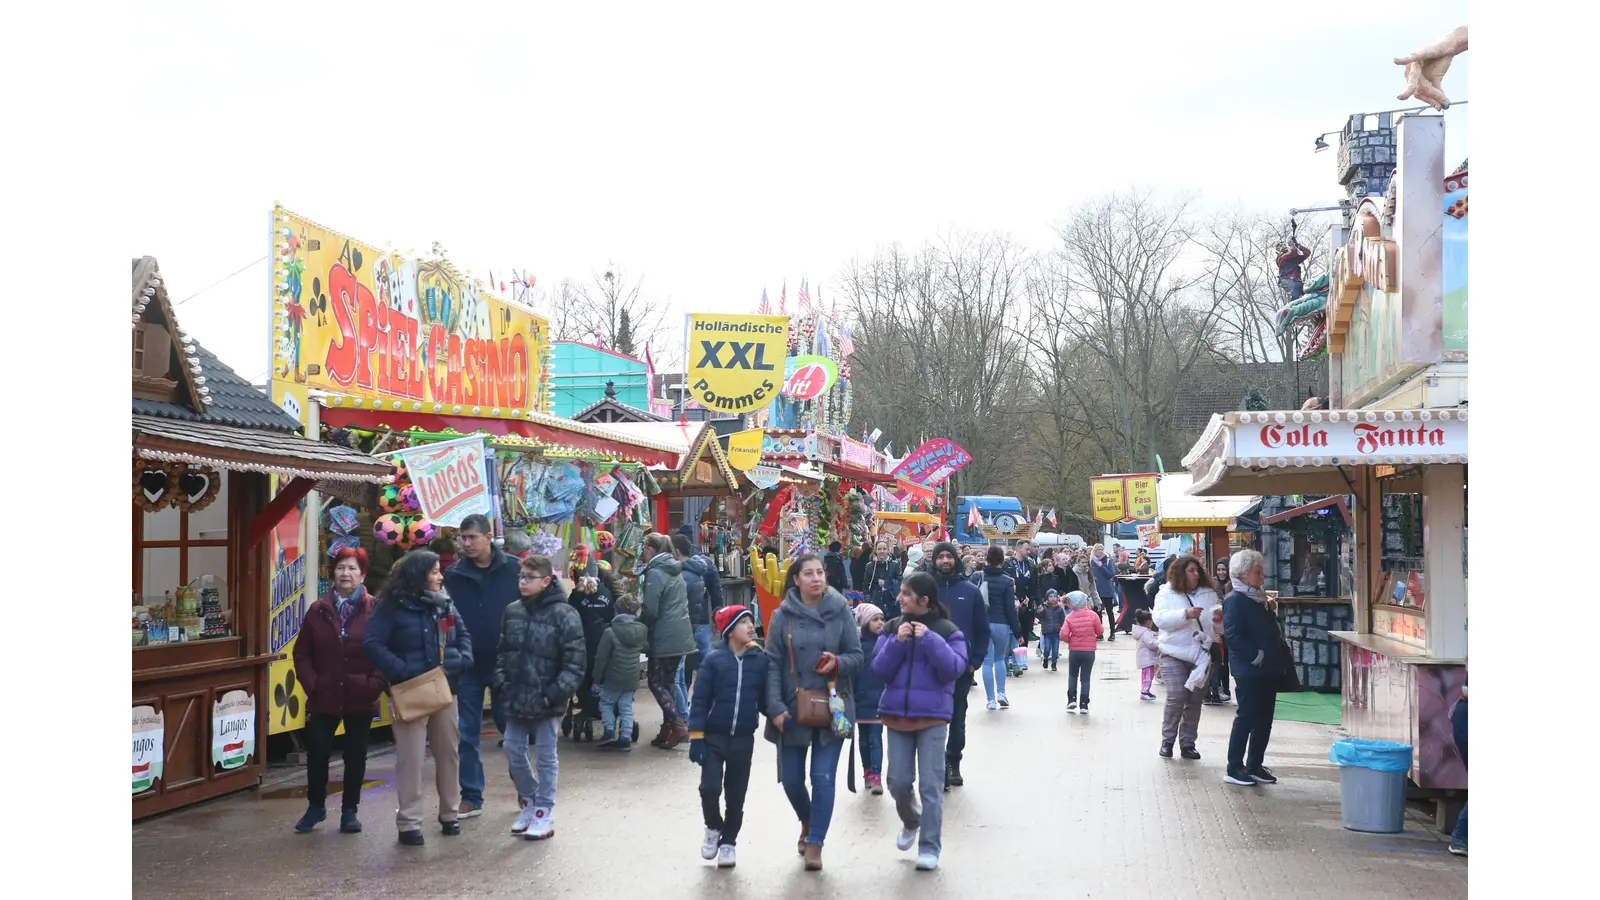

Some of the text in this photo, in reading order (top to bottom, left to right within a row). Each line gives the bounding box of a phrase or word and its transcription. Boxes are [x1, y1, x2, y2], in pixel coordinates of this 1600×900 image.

[694, 319, 784, 335] Holländische
[696, 340, 775, 371] XXL
[693, 377, 775, 410] Pommes
[1260, 422, 1445, 454] Cola Fanta
[1135, 481, 1148, 489] Bier
[1134, 496, 1152, 504] Fass
[271, 554, 305, 612] MONTE
[271, 592, 305, 654] CARLO
[220, 718, 248, 740] Langos
[132, 738, 154, 761] ngos
